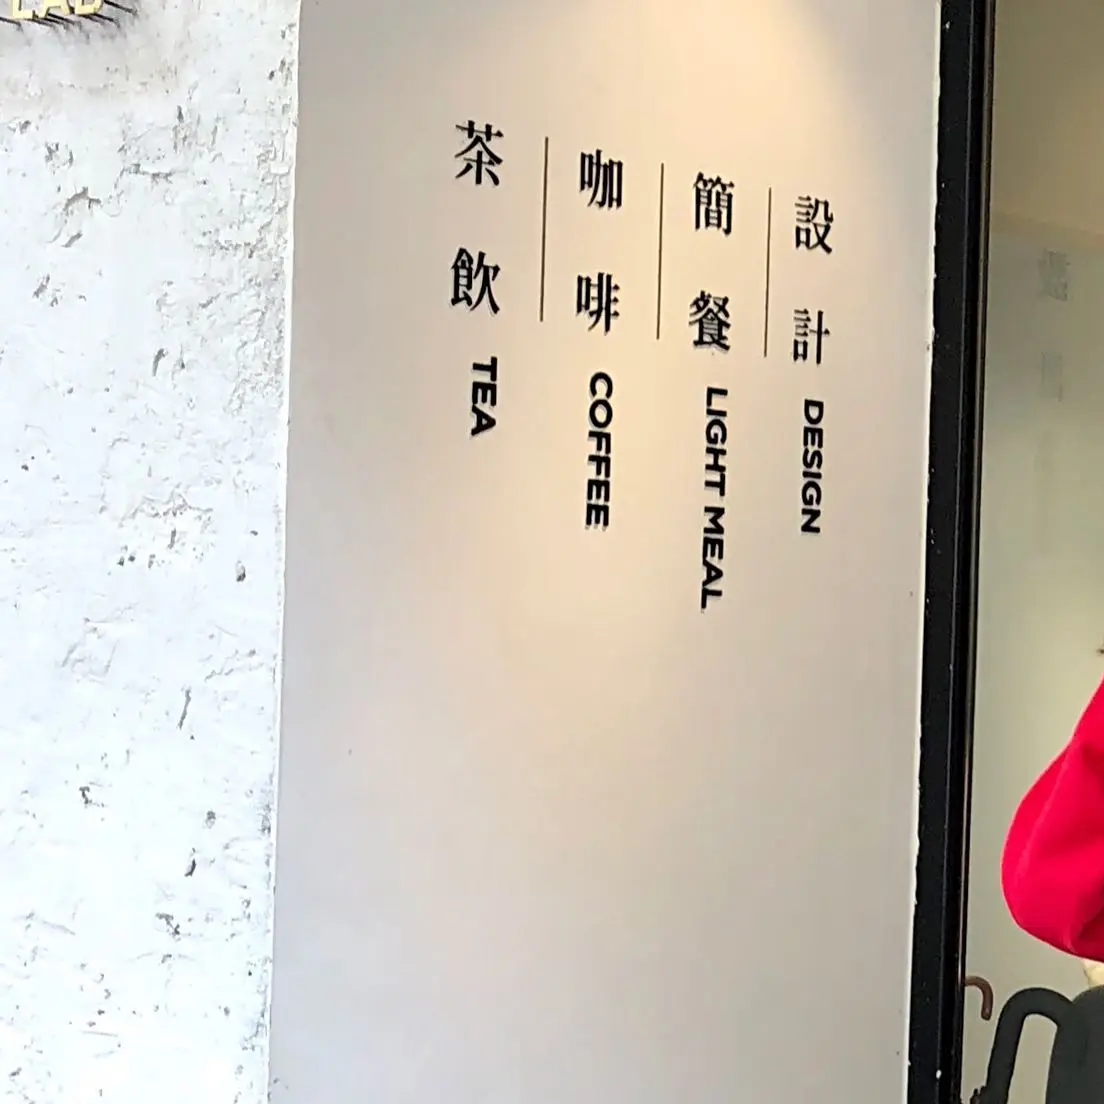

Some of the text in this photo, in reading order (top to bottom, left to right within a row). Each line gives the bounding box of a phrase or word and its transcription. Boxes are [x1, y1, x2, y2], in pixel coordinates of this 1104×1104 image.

[450, 119, 504, 316] 茶飲
[576, 149, 624, 334] 咖啡
[688, 172, 735, 352] 簡餐
[793, 195, 834, 366] 設計
[470, 356, 498, 437] TEA
[585, 371, 613, 528] COFFEE
[800, 398, 825, 534] DESIGN
[700, 386, 729, 610] LIGHT MEAL
